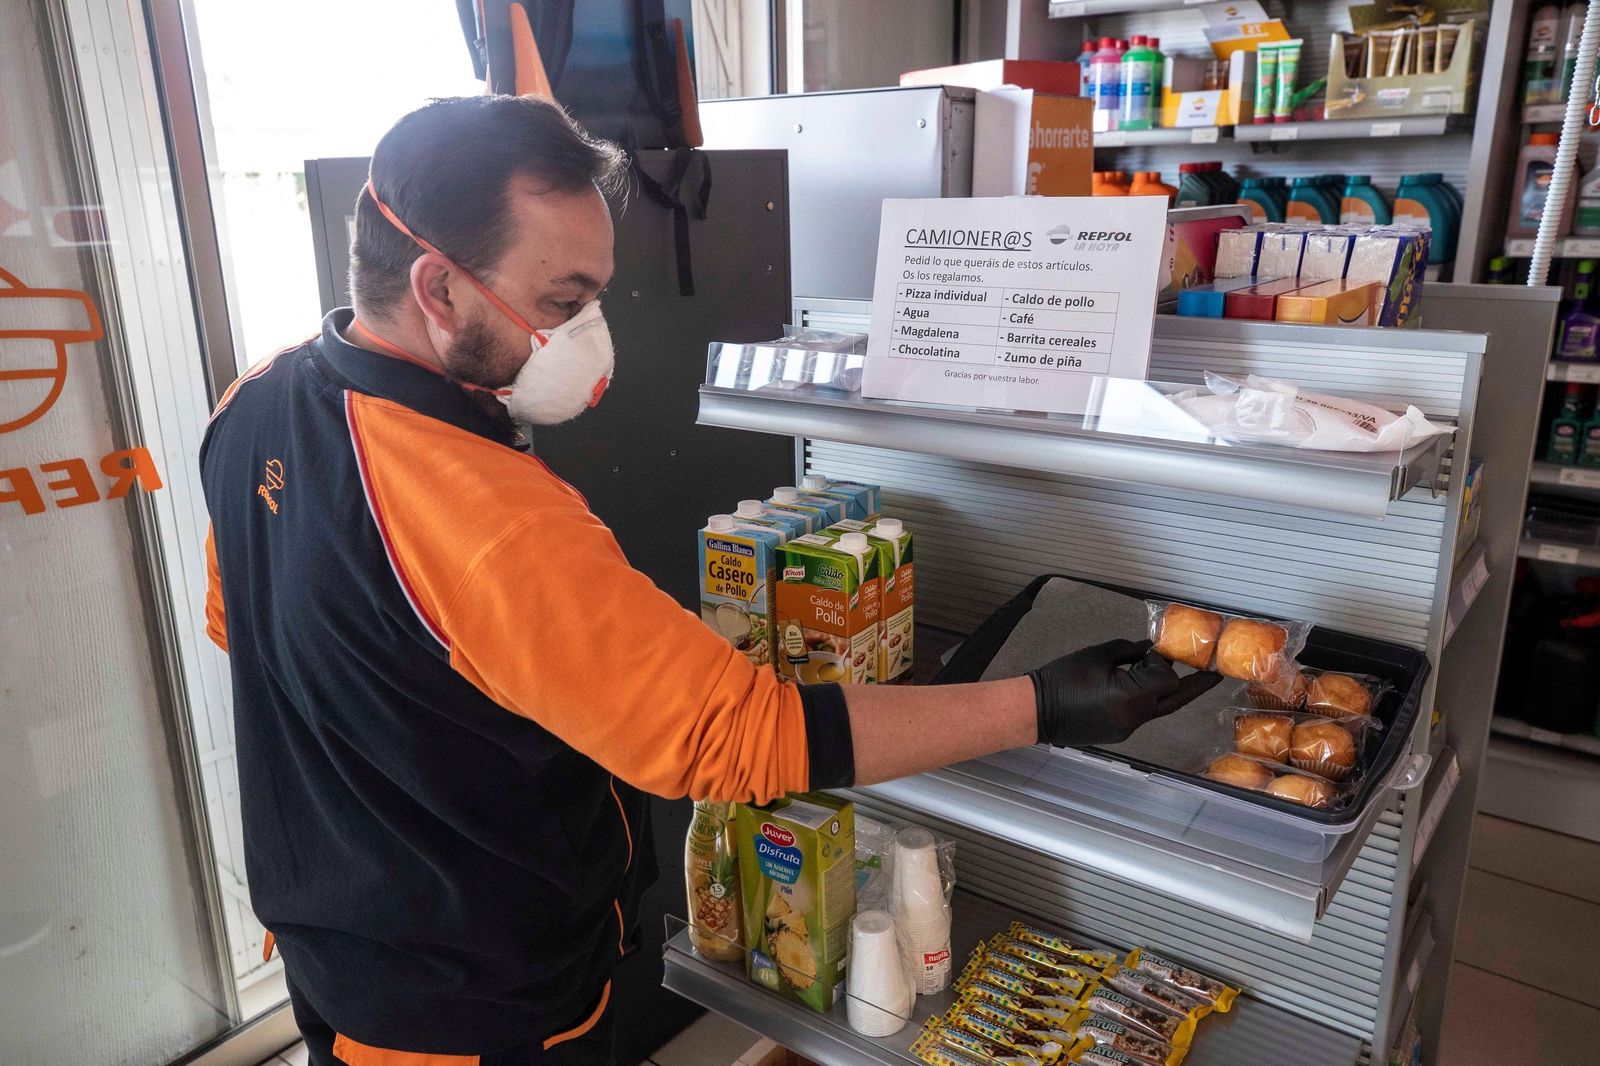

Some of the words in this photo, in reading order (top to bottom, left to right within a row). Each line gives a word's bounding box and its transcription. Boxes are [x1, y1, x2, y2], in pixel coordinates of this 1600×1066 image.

[906, 228, 1032, 250] CAMIONER@S
[1077, 231, 1133, 242] REPSOL
[1073, 241, 1086, 252] LA
[1087, 241, 1121, 252] HOYA
[904, 255, 931, 266] Pedid
[932, 256, 942, 267] lo
[943, 258, 962, 269] que
[964, 258, 1000, 269] queráis
[1002, 259, 1015, 269] de
[1017, 261, 1043, 270] estos
[1045, 260, 1093, 272] artículos.
[902, 270, 915, 280] Os
[917, 270, 931, 281] los
[932, 272, 984, 284] regalamos.
[905, 288, 931, 300] Pizza
[933, 289, 988, 303] individual
[1012, 293, 1045, 305] Caldo
[1047, 295, 1062, 307] de
[1064, 296, 1095, 309] pollo
[902, 307, 930, 320] Agua
[1009, 312, 1035, 325] Café
[900, 325, 960, 339] Magdalena
[1007, 332, 1046, 346] Barrita
[1048, 337, 1097, 349] cereales
[898, 344, 961, 359] Chocolatina
[1003, 352, 1037, 364] Zumo
[1039, 354, 1054, 366] de
[1056, 356, 1082, 369] piña
[944, 369, 972, 379] Gracias
[973, 373, 987, 381] por
[988, 374, 1017, 383] vuestra
[1018, 375, 1040, 385] labor.
[708, 540, 732, 552] Gallina
[732, 543, 754, 557] Blanca
[720, 555, 742, 568] Caldo
[708, 560, 755, 586] Casero
[784, 568, 805, 577] Knorr
[818, 564, 845, 580] Caldo
[716, 584, 724, 593] de
[725, 583, 747, 598] Pollo
[810, 594, 834, 609] Caldo
[834, 601, 845, 612] de
[815, 606, 845, 627] Pollo
[764, 826, 793, 843] Juver
[759, 843, 800, 866] Disfruta
[1139, 951, 1179, 970] NATURE
[1091, 989, 1133, 1008] NATURE
[1081, 1018, 1126, 1035] NATURE
[1085, 1045, 1130, 1064] NATURE
